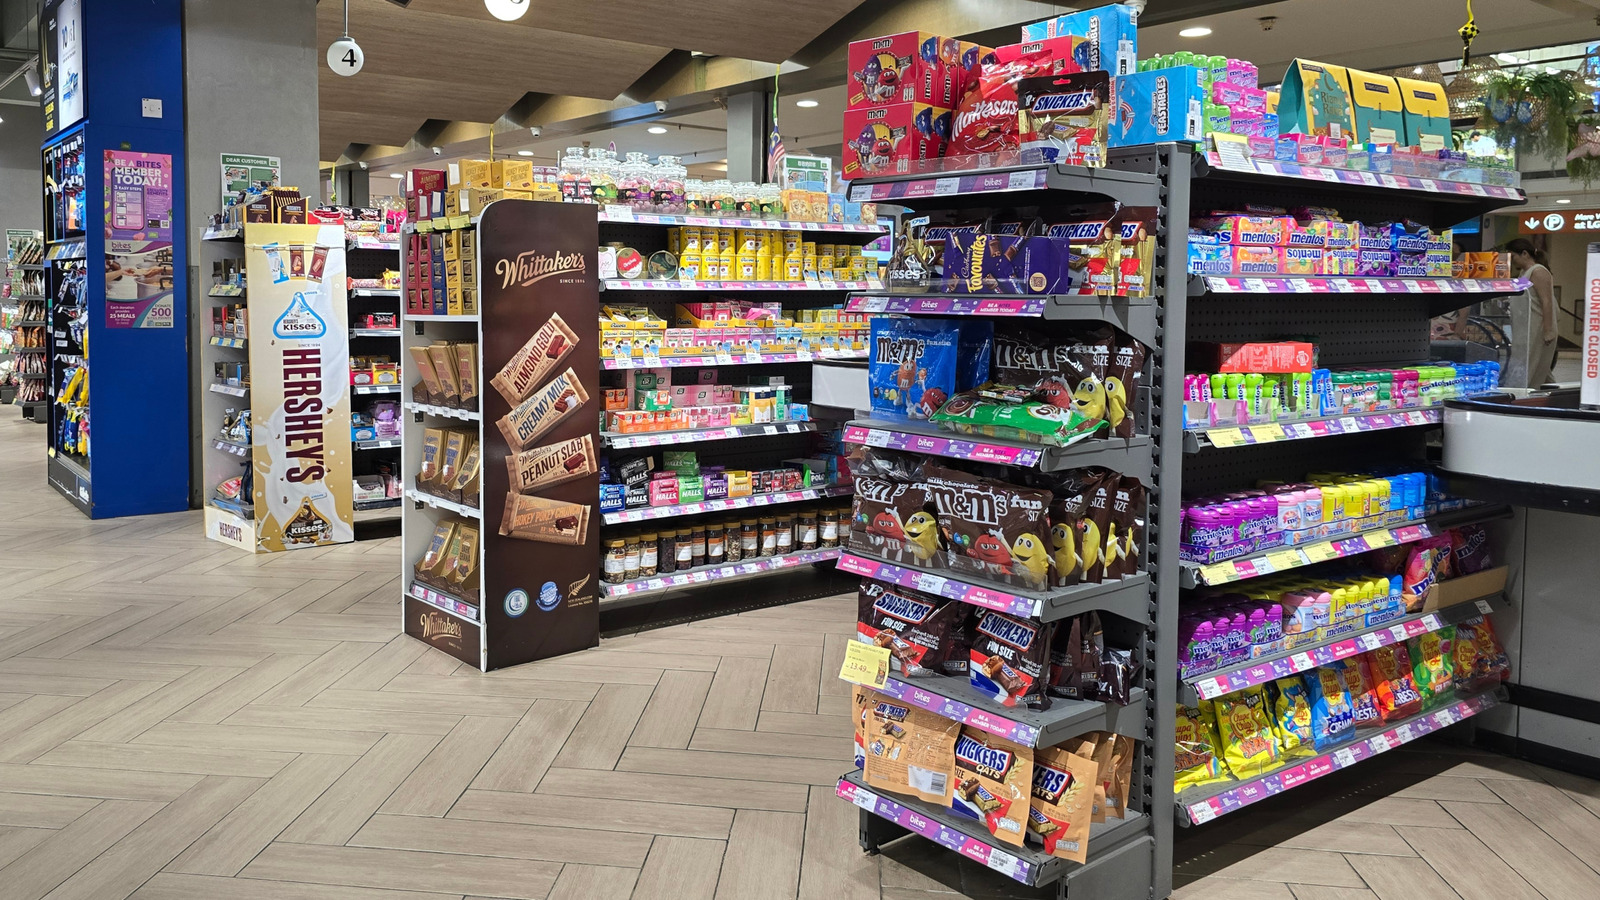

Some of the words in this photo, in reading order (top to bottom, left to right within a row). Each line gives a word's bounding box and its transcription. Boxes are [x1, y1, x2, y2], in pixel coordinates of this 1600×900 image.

[1089, 15, 1100, 72] FEASTABLES
[341, 48, 357, 68] 4
[1032, 92, 1095, 113] SNICKERS
[1156, 76, 1169, 136] FEASTABLES
[951, 99, 1019, 143] Maltesers
[1301, 145, 1323, 154] mentos
[1325, 149, 1347, 157] mentos
[114, 158, 127, 167] BE
[128, 159, 135, 167] A
[136, 160, 162, 169] BITES
[241, 158, 268, 166] CUSTOMER
[114, 167, 162, 177] MEMBER
[114, 174, 162, 187] TODAY!
[983, 177, 1003, 187] bites
[478, 193, 499, 205] PEANUT
[1574, 213, 1594, 222] More
[1049, 223, 1103, 238] SNICKERS
[1573, 221, 1587, 230] at
[1241, 231, 1277, 244] mentos
[1290, 233, 1325, 245] mentos
[1327, 238, 1351, 247] mentos
[1360, 237, 1391, 249] mentos
[1398, 238, 1428, 250] mentos
[111, 241, 132, 249] bites
[1426, 241, 1451, 251] mentos
[1287, 248, 1322, 260] mentos
[1332, 250, 1358, 259] mentos
[1361, 251, 1391, 262] mentos
[1426, 253, 1451, 263] mentos
[495, 249, 586, 290] Whittaker's
[965, 234, 988, 294] Favourites
[1192, 260, 1231, 273] mentos
[1241, 262, 1278, 273] mentos
[1398, 265, 1427, 275] mentos
[921, 300, 939, 309] bites
[1588, 278, 1600, 333] COUNTER
[151, 307, 172, 317] 500
[537, 320, 556, 352] GOLD
[1093, 354, 1110, 366] SIZE
[1115, 354, 1134, 368] SIZE
[1586, 334, 1600, 379] CLOSED
[513, 345, 543, 394] ALMOND
[546, 374, 570, 401] MILK
[281, 348, 326, 485] HERSHEY'S
[517, 397, 550, 441] CREAMY
[561, 436, 584, 461] SLAB
[917, 438, 935, 448] bites
[521, 454, 561, 486] PEANUT
[626, 470, 649, 485] HALLS
[810, 473, 825, 482] POLO
[927, 477, 946, 485] milk
[945, 480, 979, 490] chocolate
[681, 489, 702, 498] HALLS
[706, 485, 727, 495] HALLS
[731, 484, 750, 492] HALLS
[626, 494, 648, 505] HALLS
[655, 492, 677, 501] HALLS
[1010, 494, 1043, 510] fun
[600, 498, 623, 509] HALLS
[1064, 502, 1081, 514] SIZE
[513, 511, 535, 527] HOKEY
[219, 521, 243, 543] HERSHEY'S
[1361, 522, 1377, 530] mentos
[1215, 545, 1244, 560] mentos
[842, 562, 858, 570] MEMBER
[858, 565, 873, 574] TODAY!
[1412, 544, 1451, 596] mentos
[875, 592, 932, 621] SNICKERS
[969, 595, 988, 605] MEMBER
[987, 599, 1005, 609] TODAY!
[1369, 610, 1395, 624] mentos
[420, 611, 463, 641] Whittaker's
[880, 616, 893, 629] FUN
[891, 621, 908, 632] SIZE
[980, 612, 1034, 649] SNICKERS
[1326, 624, 1353, 638] mentos
[986, 640, 1000, 654] FUN
[998, 645, 1016, 661] SIZE
[849, 662, 868, 673] 13.49
[913, 690, 931, 703] bites
[1399, 689, 1417, 704] BEST
[1233, 712, 1250, 723] Chupa
[970, 717, 989, 729] MEMBER
[989, 723, 1007, 734] TODAY!
[1235, 720, 1254, 733] Chups
[956, 736, 1007, 771] NICKERS
[976, 764, 1001, 779] OATS
[1033, 788, 1055, 801] ATS
[909, 814, 927, 828] bites
[966, 847, 985, 860] MEMBER
